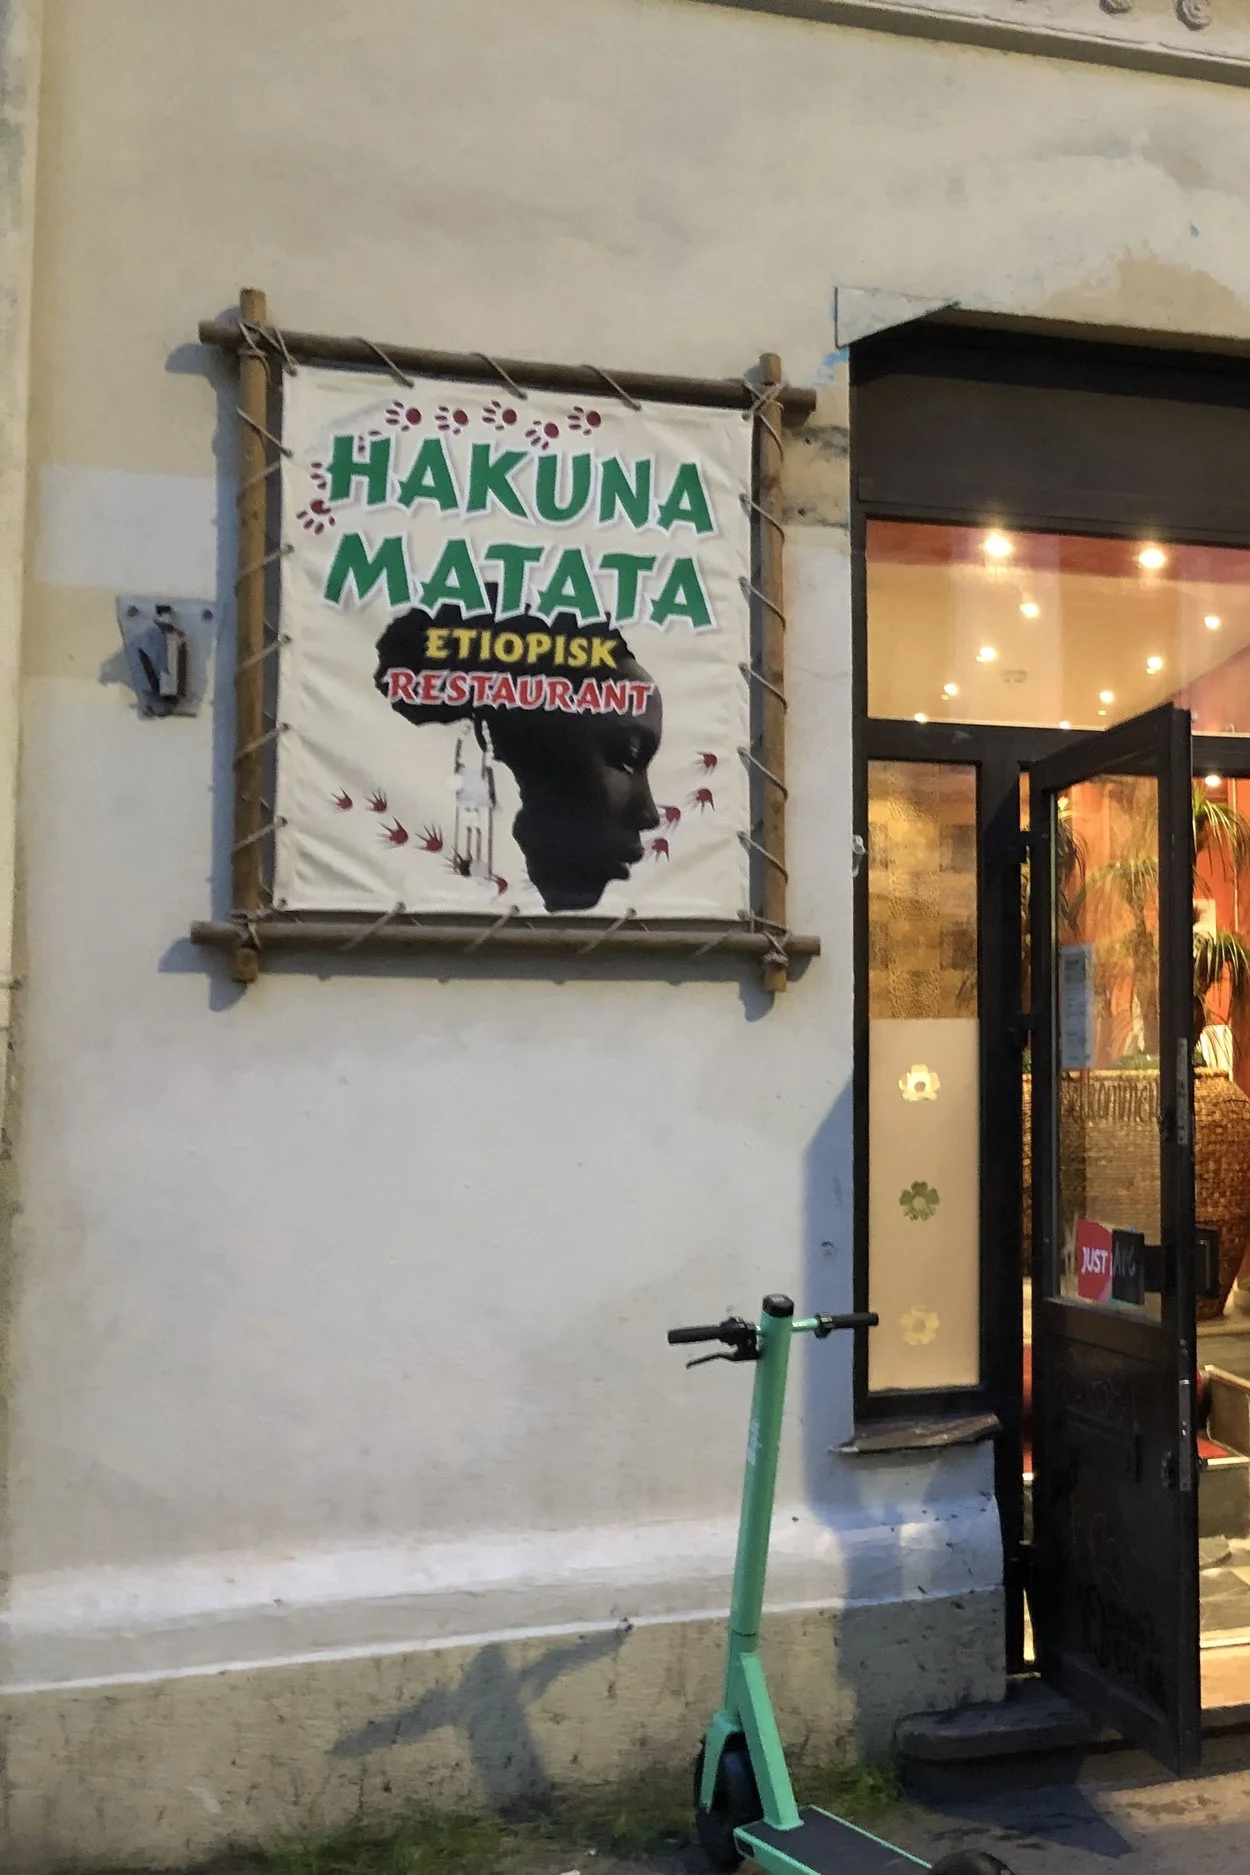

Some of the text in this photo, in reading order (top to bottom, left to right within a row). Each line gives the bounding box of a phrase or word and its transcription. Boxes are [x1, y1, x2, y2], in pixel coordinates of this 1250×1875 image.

[328, 434, 716, 534] HAKUNA
[324, 532, 714, 630] MATATA
[425, 628, 617, 668] ETIOPISK
[387, 671, 652, 714] RESTAURANT
[1081, 1246, 1108, 1275] JUST
